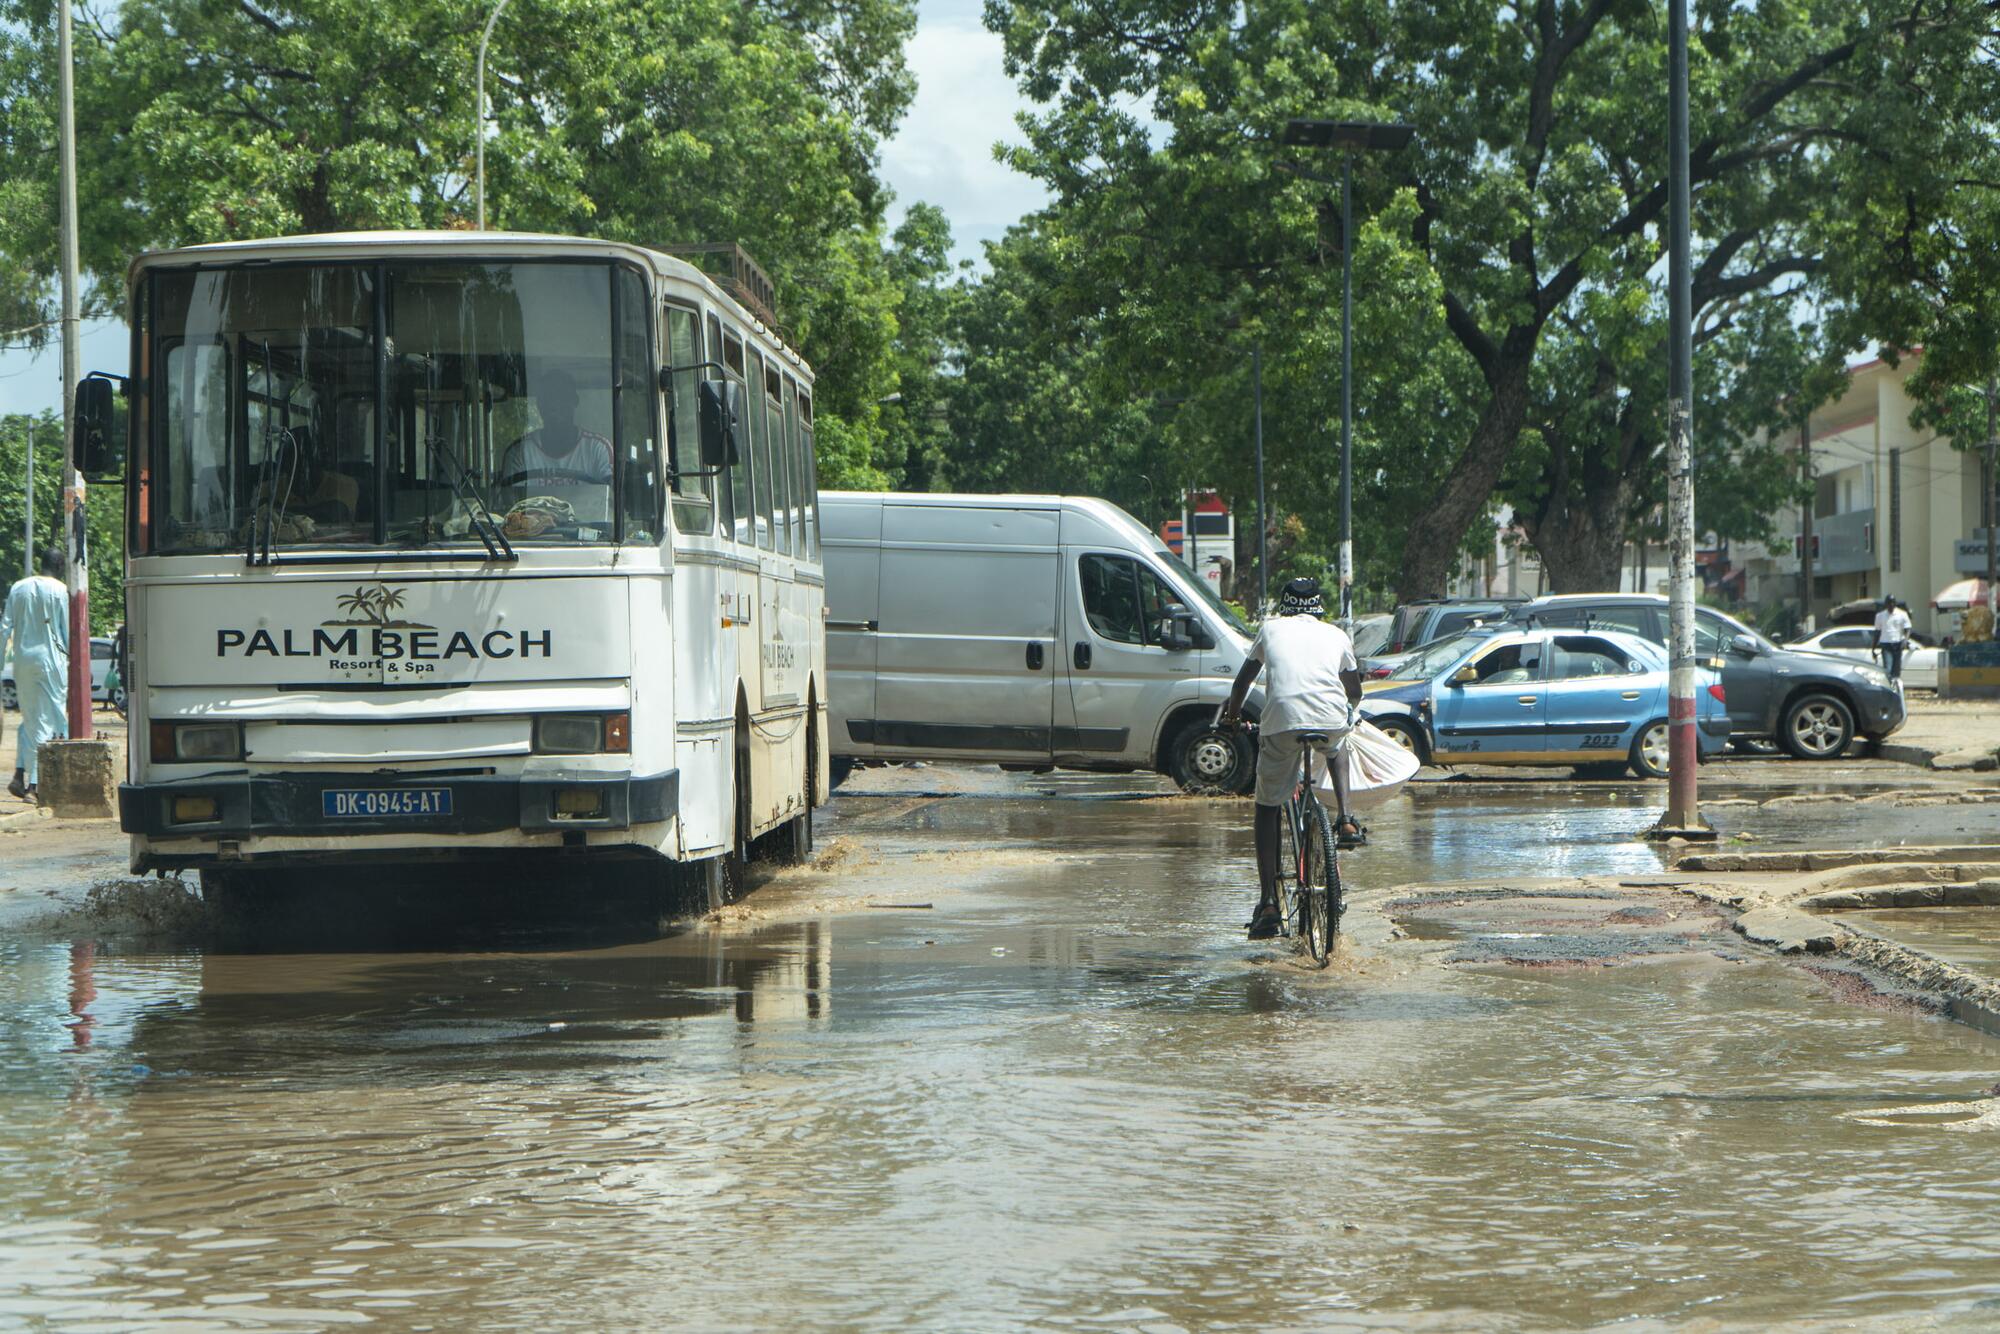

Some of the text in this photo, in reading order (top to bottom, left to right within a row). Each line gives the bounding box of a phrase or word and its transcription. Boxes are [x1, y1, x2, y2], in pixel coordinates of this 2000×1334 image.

[1284, 592, 1320, 606] DO NOT
[217, 629, 551, 660] PALM BEACH
[329, 659, 435, 674] Resort & Spa
[336, 791, 441, 814] DK-0945-AT
